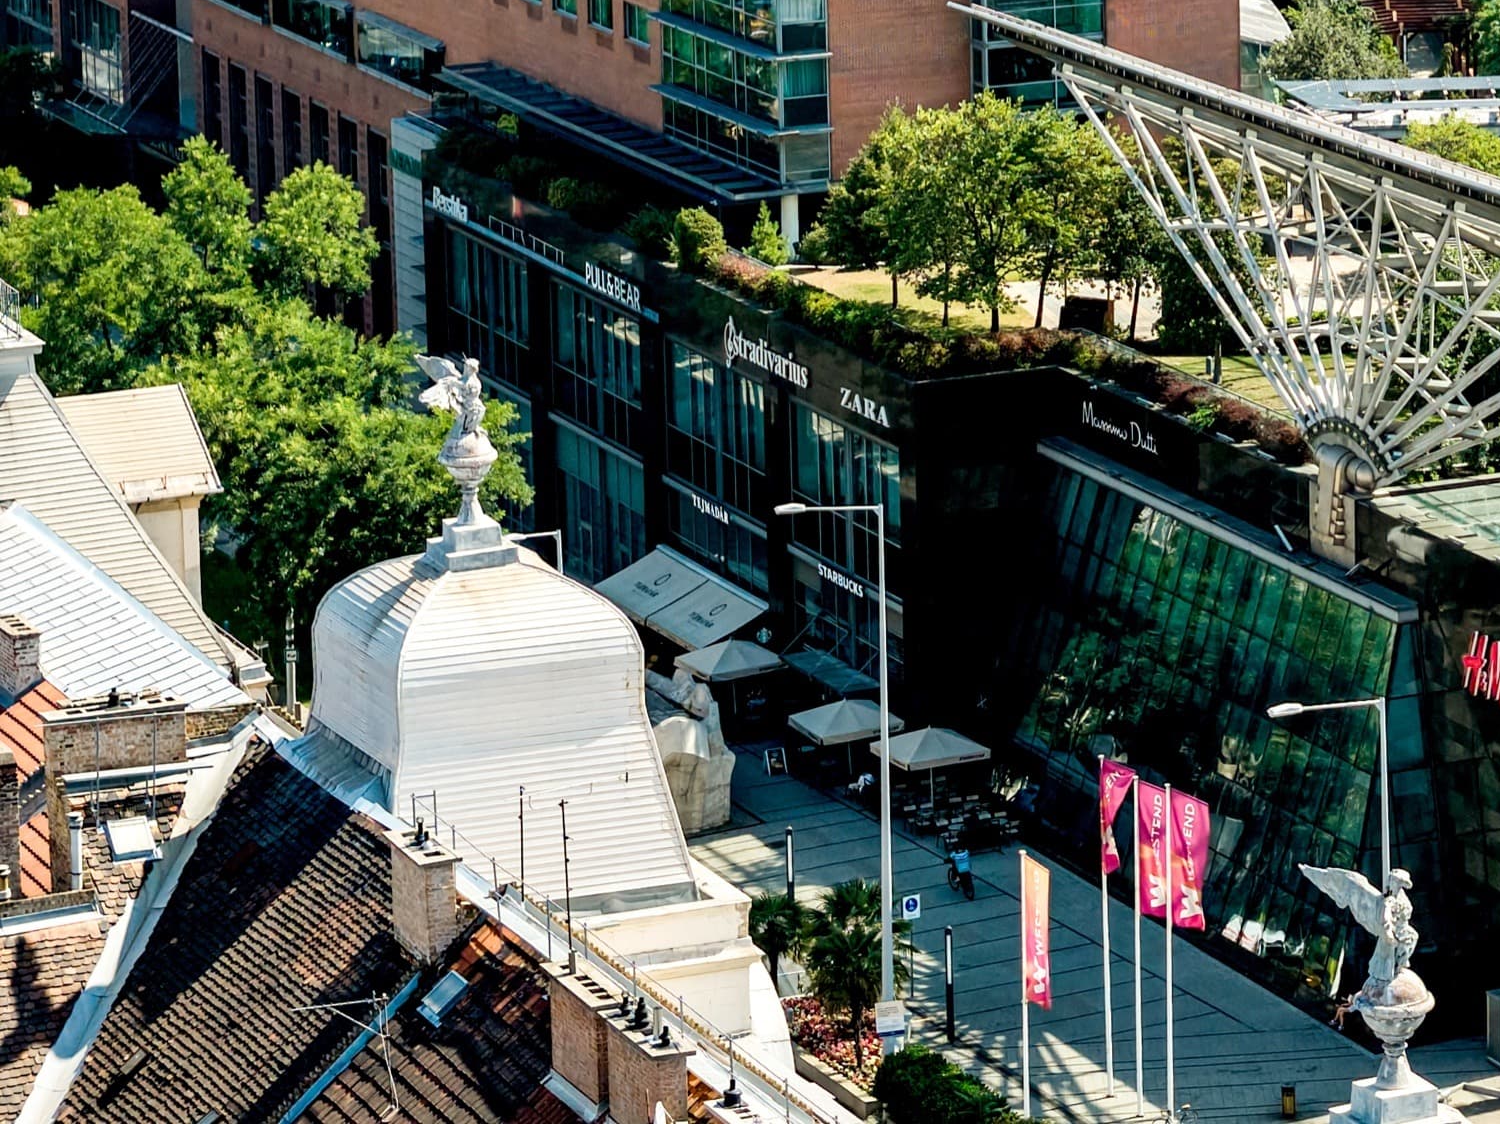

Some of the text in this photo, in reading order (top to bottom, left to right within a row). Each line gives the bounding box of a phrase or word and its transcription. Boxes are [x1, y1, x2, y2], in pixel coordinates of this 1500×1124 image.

[585, 261, 641, 312] PULL&BEAR
[840, 387, 891, 428] ZARA
[1082, 400, 1159, 456] Massimo Dutti
[817, 563, 864, 599] STARBUCKS
